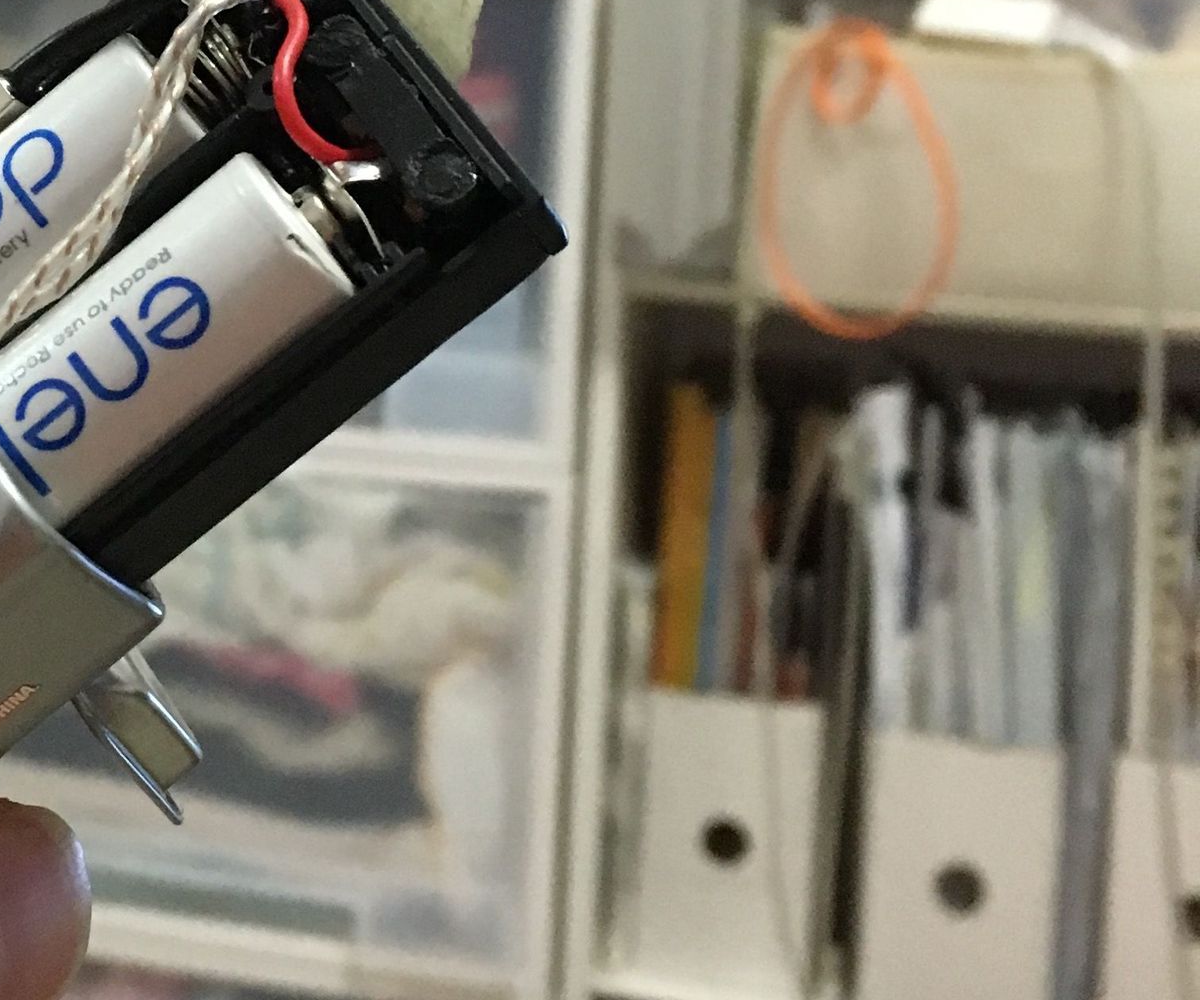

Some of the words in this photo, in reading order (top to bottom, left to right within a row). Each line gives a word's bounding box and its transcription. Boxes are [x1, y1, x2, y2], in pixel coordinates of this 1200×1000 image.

[110, 247, 173, 303] Ready
[87, 298, 109, 320] to
[53, 316, 86, 347] use
